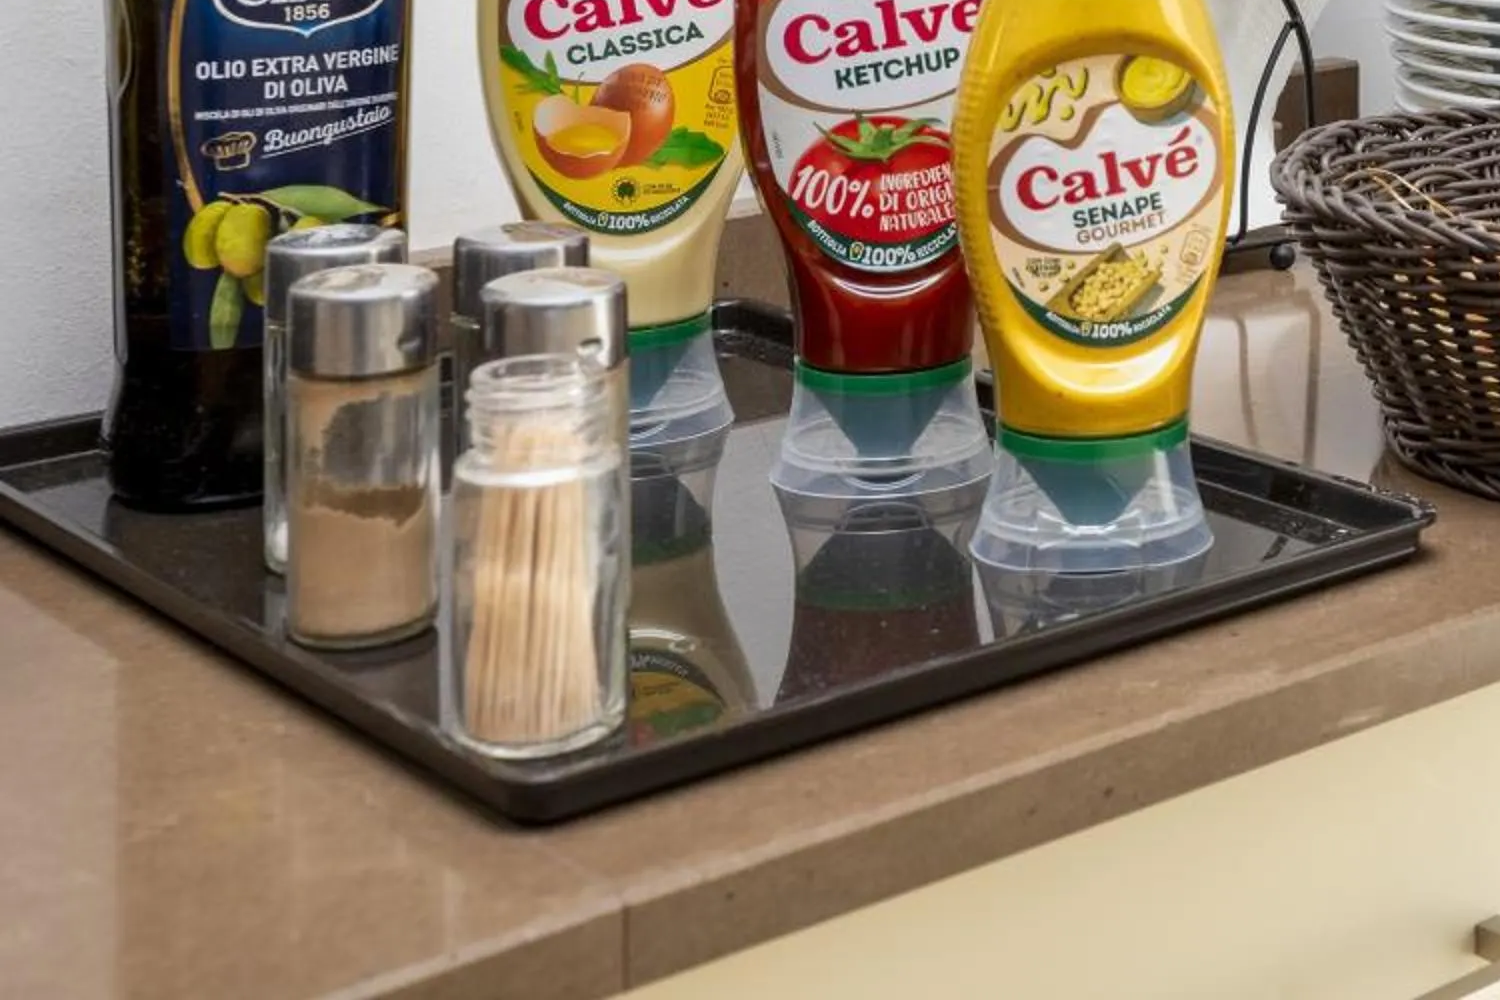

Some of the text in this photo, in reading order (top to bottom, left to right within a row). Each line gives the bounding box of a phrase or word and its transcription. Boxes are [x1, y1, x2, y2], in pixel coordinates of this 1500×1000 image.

[284, 3, 331, 23] 1856
[566, 21, 704, 65] CLASSICA
[195, 43, 400, 81] OLIO EXTRA VERGINE
[834, 47, 960, 90] KETCHUP
[264, 74, 348, 100] DI OLIVA
[263, 105, 392, 153] Buongustaio
[879, 162, 953, 191] INGREDIEN
[1015, 125, 1199, 212] Calvé
[791, 165, 875, 219] 100%
[879, 181, 954, 213] DI ORIGI
[1072, 191, 1163, 229] SENAPE
[607, 213, 650, 230] 100%
[879, 202, 955, 233] NATURALE
[1076, 210, 1168, 245] GOURMET
[862, 243, 917, 266] 100%
[916, 222, 958, 258] RICICLA
[1091, 322, 1133, 339] 100%
